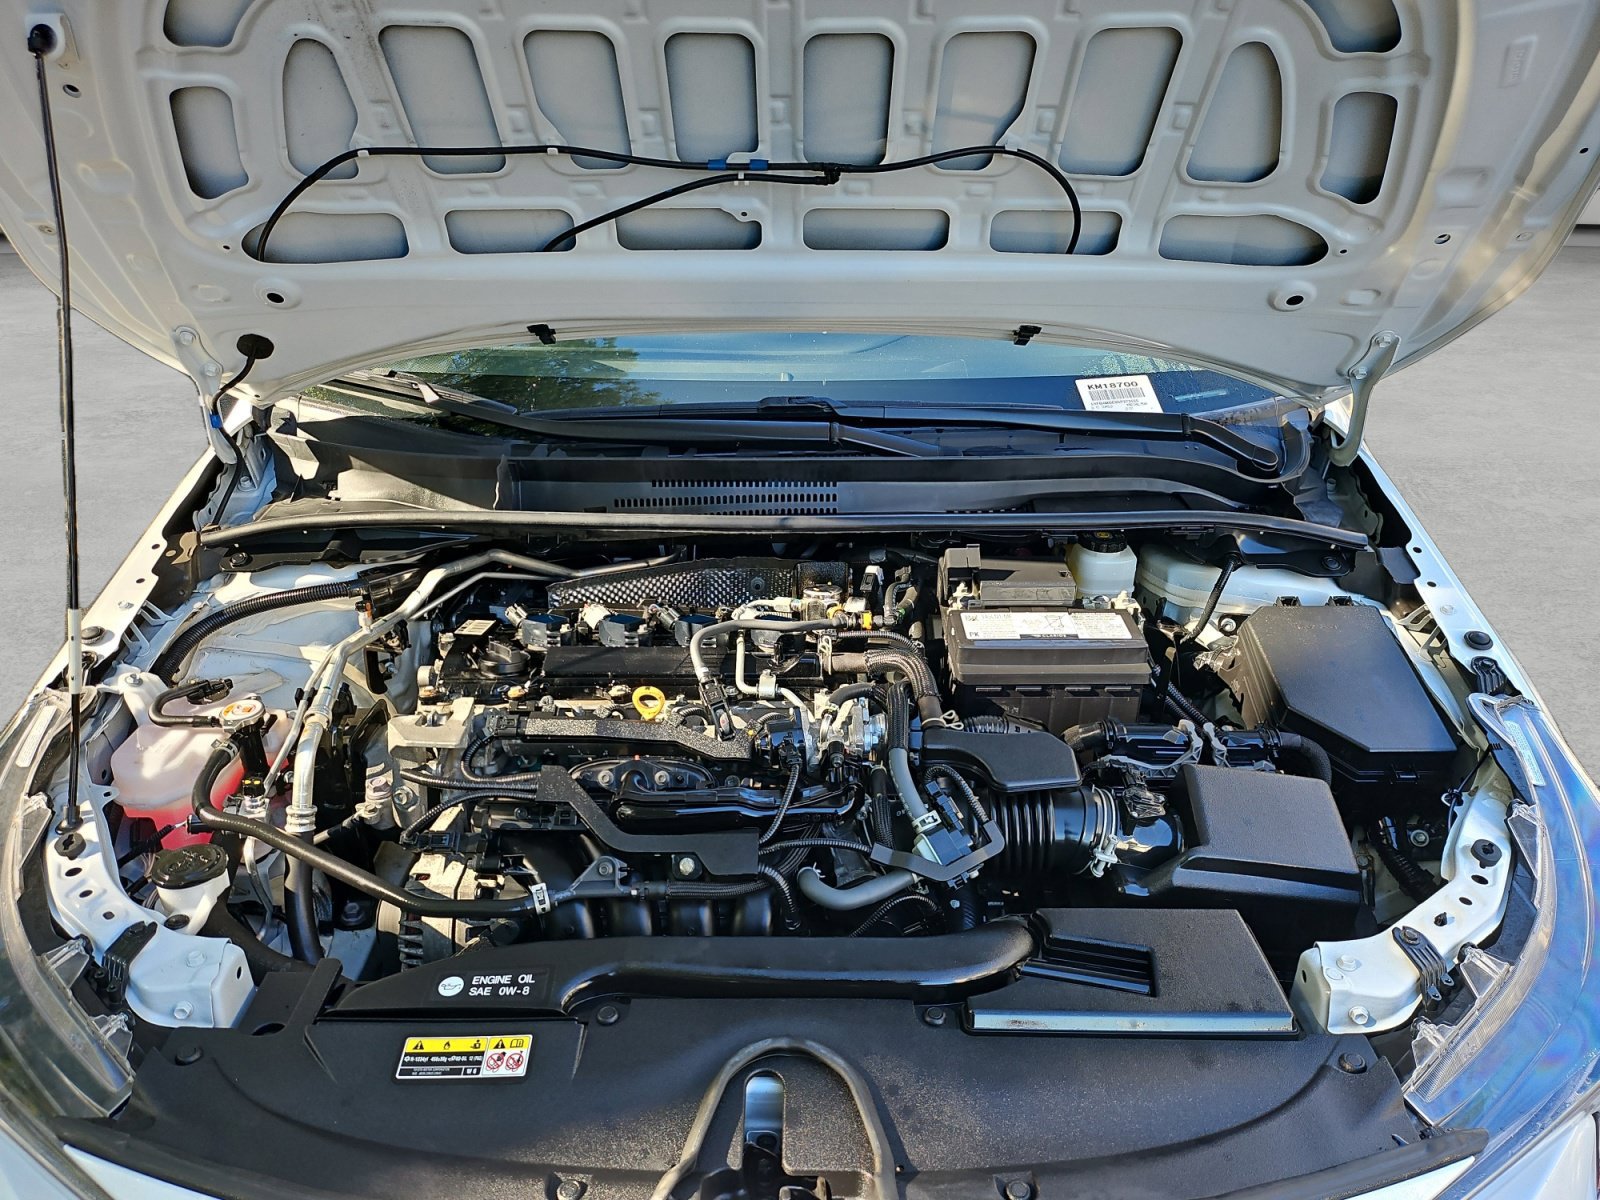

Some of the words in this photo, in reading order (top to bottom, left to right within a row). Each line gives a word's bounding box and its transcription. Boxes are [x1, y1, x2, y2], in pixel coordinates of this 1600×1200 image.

[1087, 381, 1138, 390] KM18700
[471, 974, 512, 985] ENGINE
[518, 974, 535, 984] OIL
[468, 986, 492, 996] SAE
[498, 986, 530, 996] 0W-8
